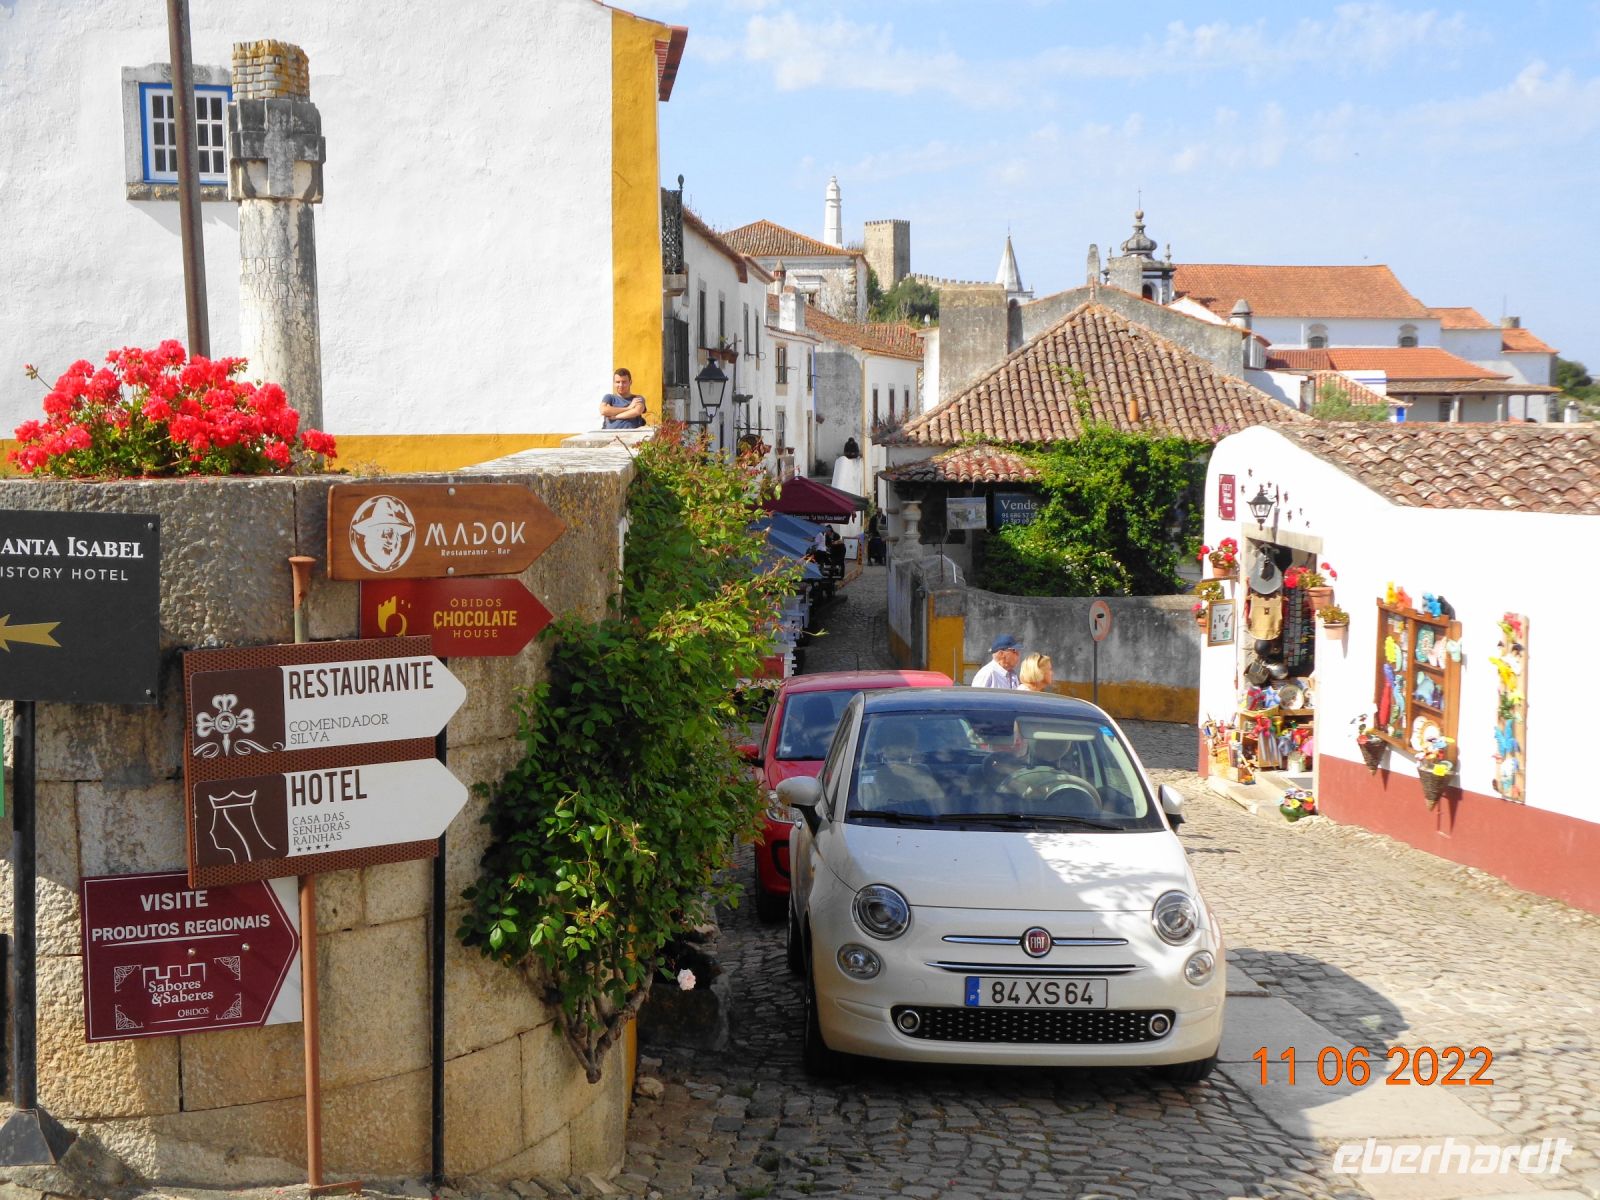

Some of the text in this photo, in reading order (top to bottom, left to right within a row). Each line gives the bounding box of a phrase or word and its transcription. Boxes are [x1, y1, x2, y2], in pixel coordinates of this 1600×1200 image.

[424, 521, 526, 546] MADOK
[0, 536, 144, 559] ANTA ISABEL
[441, 547, 488, 557] Restaurante
[497, 547, 511, 555] Bar
[0, 566, 129, 581] ISTORY HOTEL
[433, 610, 518, 628] CHOCOLATE
[453, 629, 498, 638] HOUSE
[288, 661, 434, 700] RESTAURANTE
[289, 713, 389, 733] COMENDADOR
[290, 731, 330, 745] SILVA
[291, 768, 368, 807] HOTEL
[292, 811, 345, 826] CASA DAS
[292, 820, 351, 836] SENHORAS
[293, 831, 343, 846] RAINHAS
[140, 890, 209, 912] VISITE
[91, 914, 271, 942] PRODUTOS REGIONAIS
[1030, 936, 1046, 949] FIAT
[148, 979, 201, 993] Sabores
